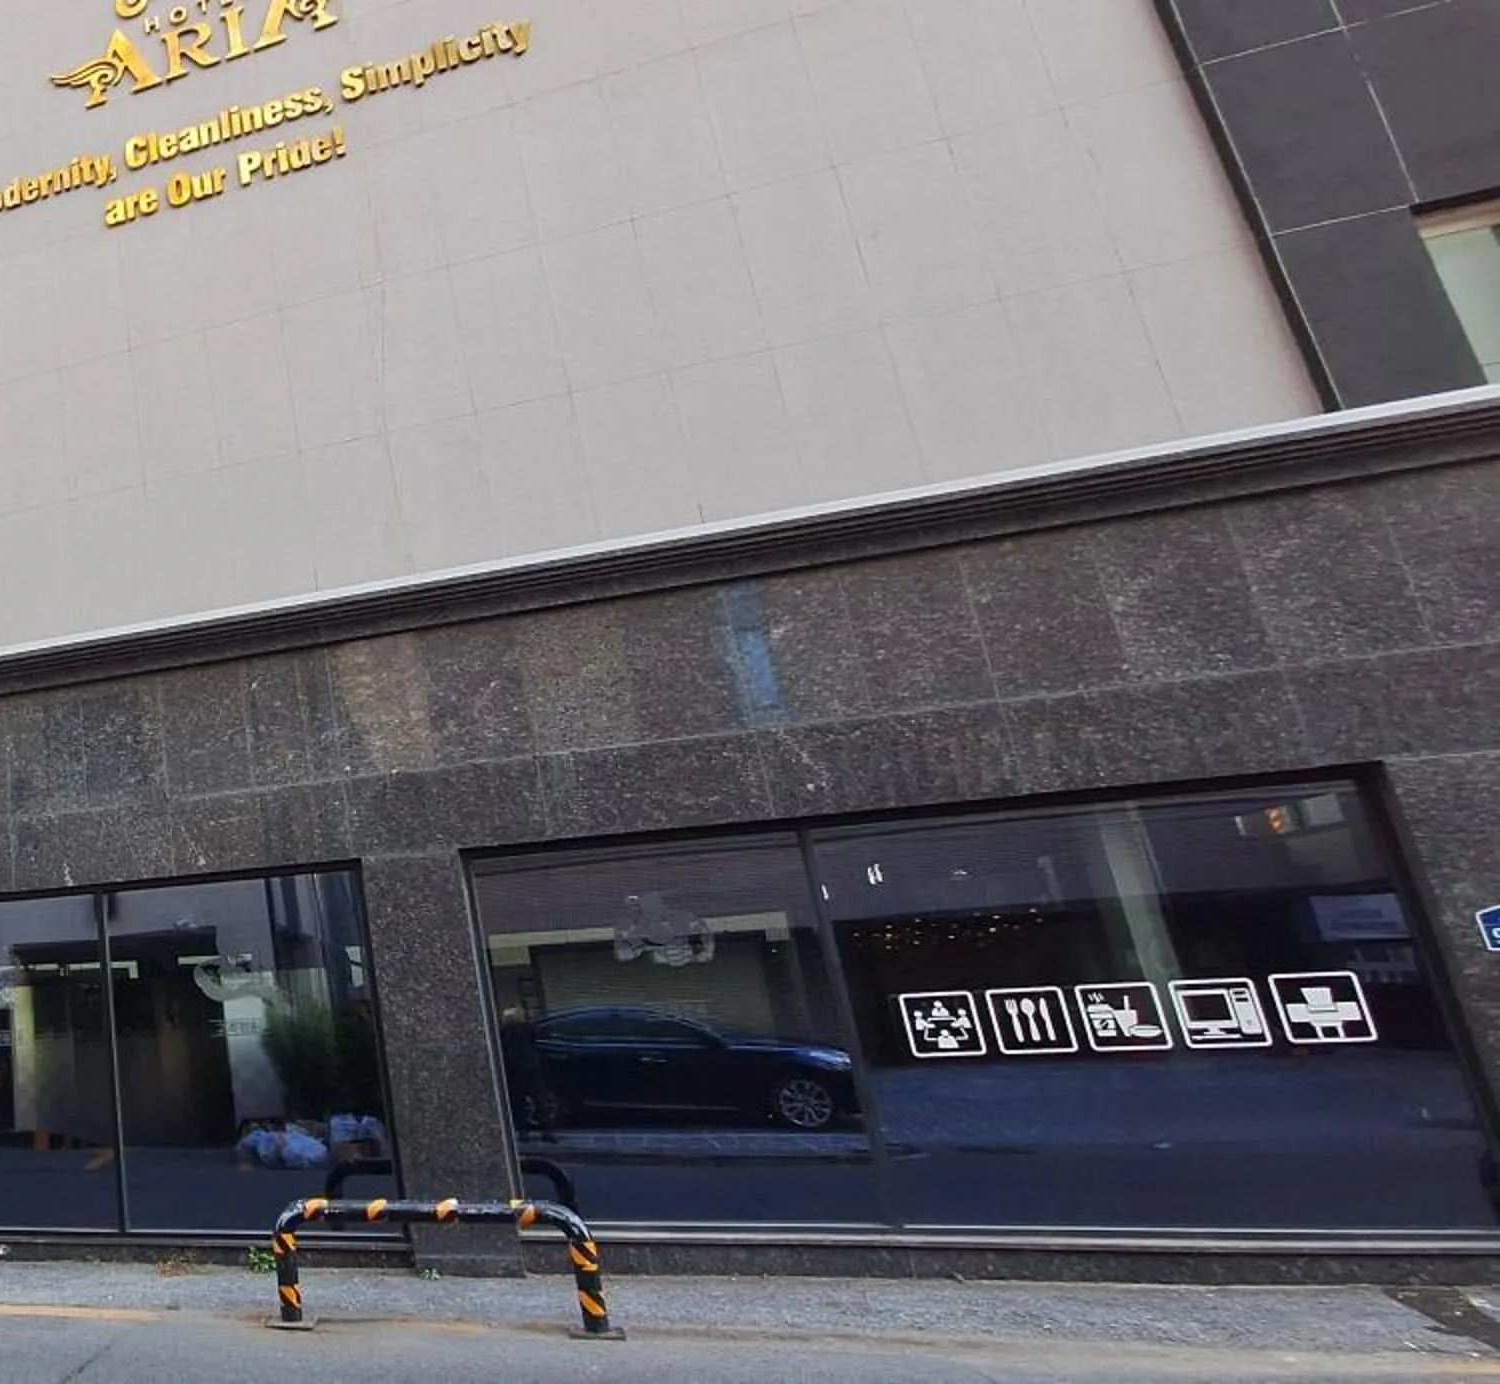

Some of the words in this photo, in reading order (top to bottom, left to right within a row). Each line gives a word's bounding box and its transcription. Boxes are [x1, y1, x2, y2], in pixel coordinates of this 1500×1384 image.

[50, 0, 338, 108] ARIA
[124, 85, 334, 171] Cleanliness,
[340, 17, 534, 103] Simplicity
[103, 181, 159, 228] are
[166, 165, 228, 209] Our
[237, 125, 348, 186] Pride!
